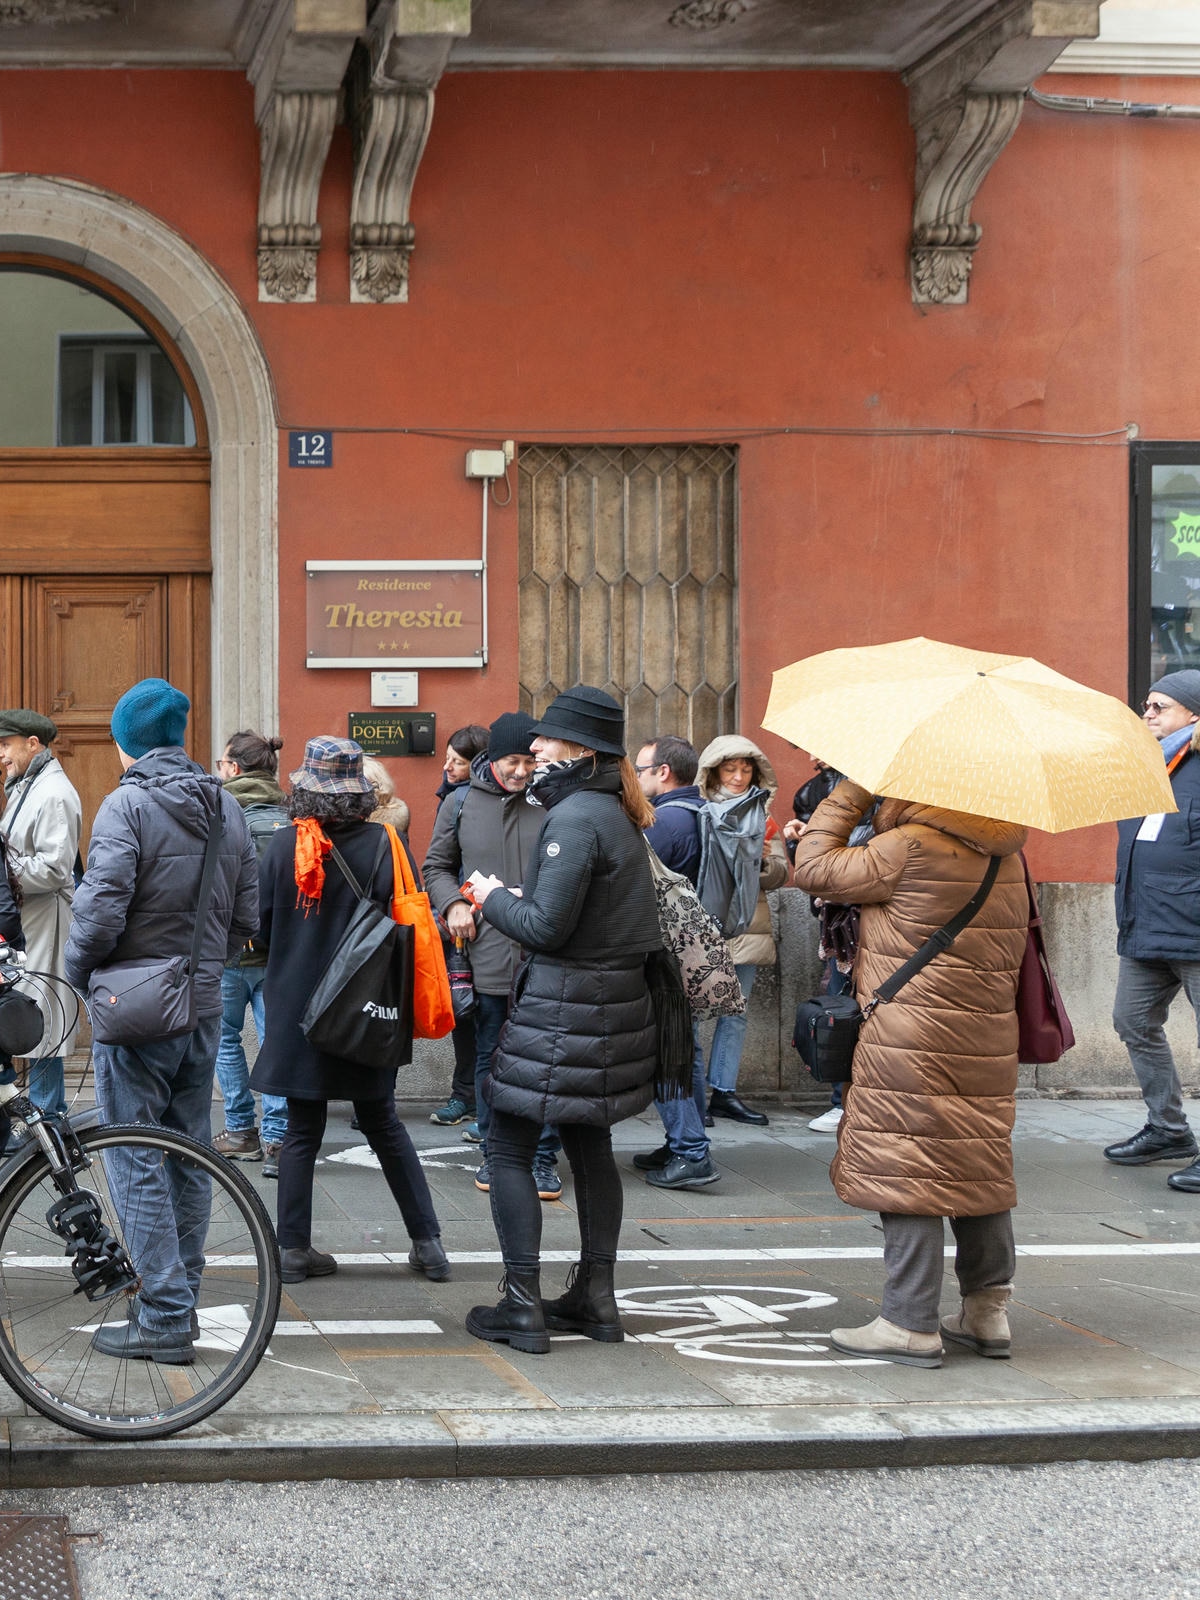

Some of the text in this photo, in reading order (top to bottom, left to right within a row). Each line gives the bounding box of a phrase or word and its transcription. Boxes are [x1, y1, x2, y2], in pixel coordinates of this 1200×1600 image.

[298, 435, 325, 456] 12
[357, 578, 432, 591] Residence
[324, 602, 464, 628] Theresia
[352, 725, 405, 739] POETA
